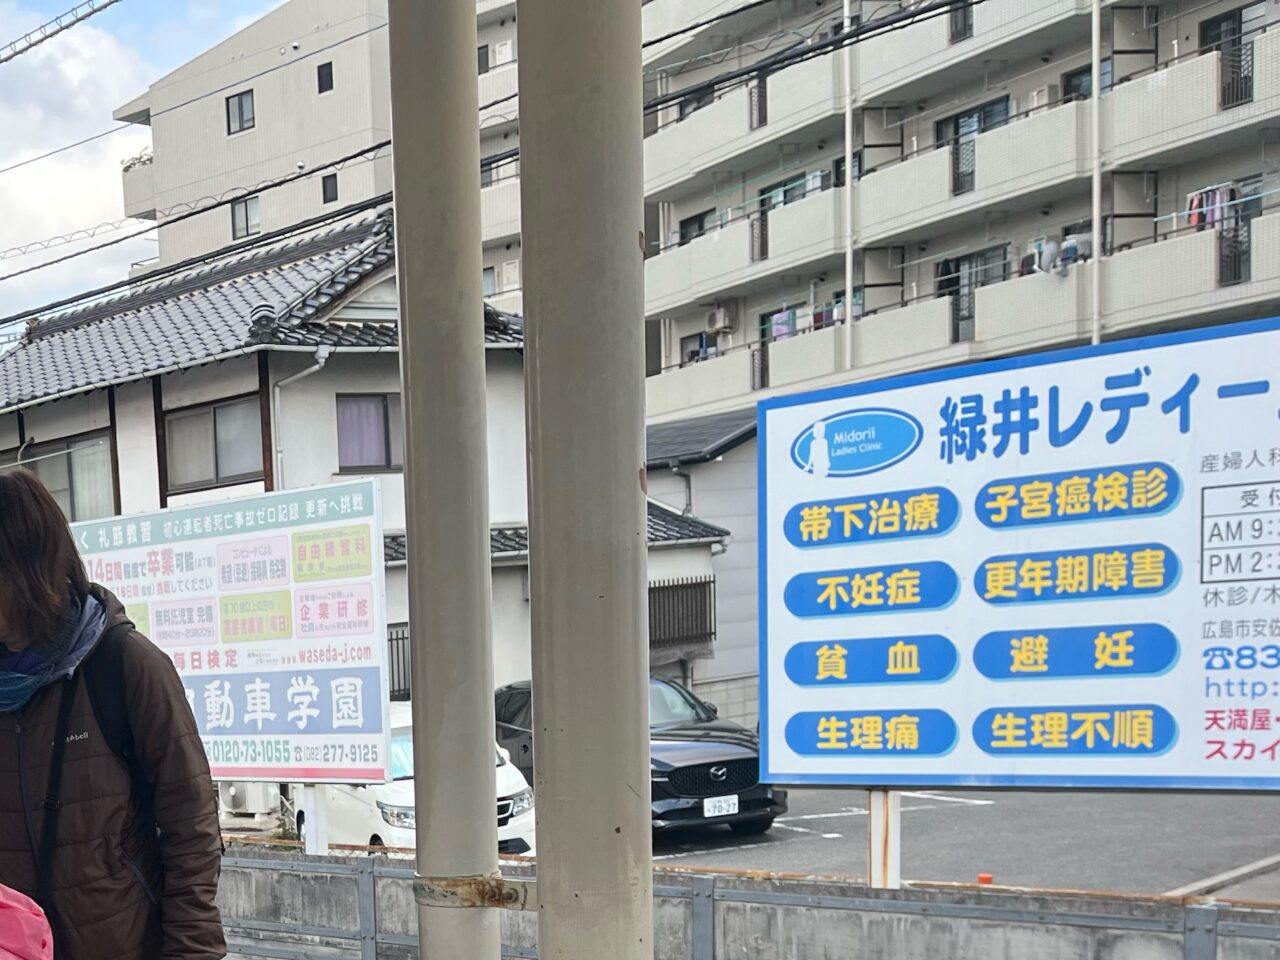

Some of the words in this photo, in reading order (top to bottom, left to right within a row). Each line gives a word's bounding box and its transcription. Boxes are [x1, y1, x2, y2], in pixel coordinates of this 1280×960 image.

[939, 365, 1280, 464] 緑井レディー
[831, 445, 857, 456] Ladies
[859, 442, 883, 453] Clinic
[833, 426, 876, 445] Midorii
[985, 467, 1169, 523] 子宮癌検診
[800, 493, 940, 541] 帯下治療
[1208, 520, 1242, 543] AM
[984, 549, 1166, 599] 更年期障害
[1209, 553, 1242, 575] PM
[817, 569, 921, 610] 不妊症
[817, 715, 919, 749] 生理痛
[991, 710, 1154, 749] 生理不順
